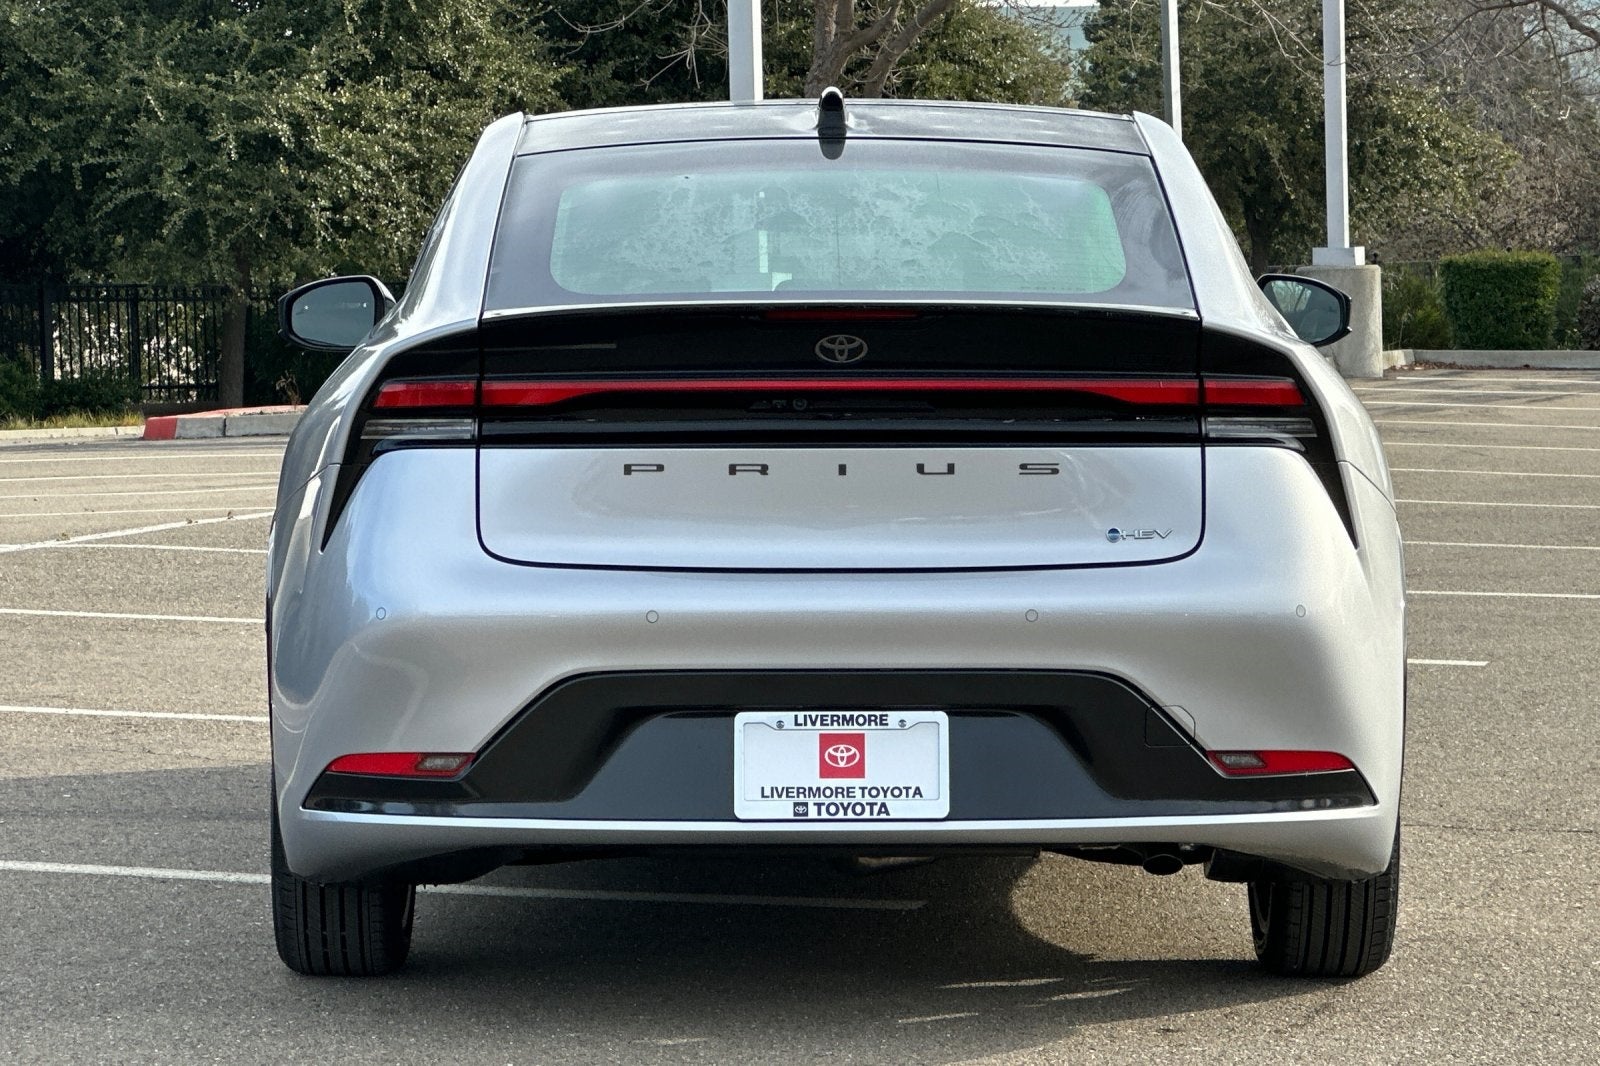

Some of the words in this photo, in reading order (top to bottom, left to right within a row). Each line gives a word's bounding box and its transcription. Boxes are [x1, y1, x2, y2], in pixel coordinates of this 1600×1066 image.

[623, 463, 1060, 476] PRIUS
[794, 714, 888, 727] LIVERMORE
[760, 786, 856, 799] LIVERMORE
[861, 786, 923, 799] TOYOTA
[813, 802, 890, 817] TOYOTA
